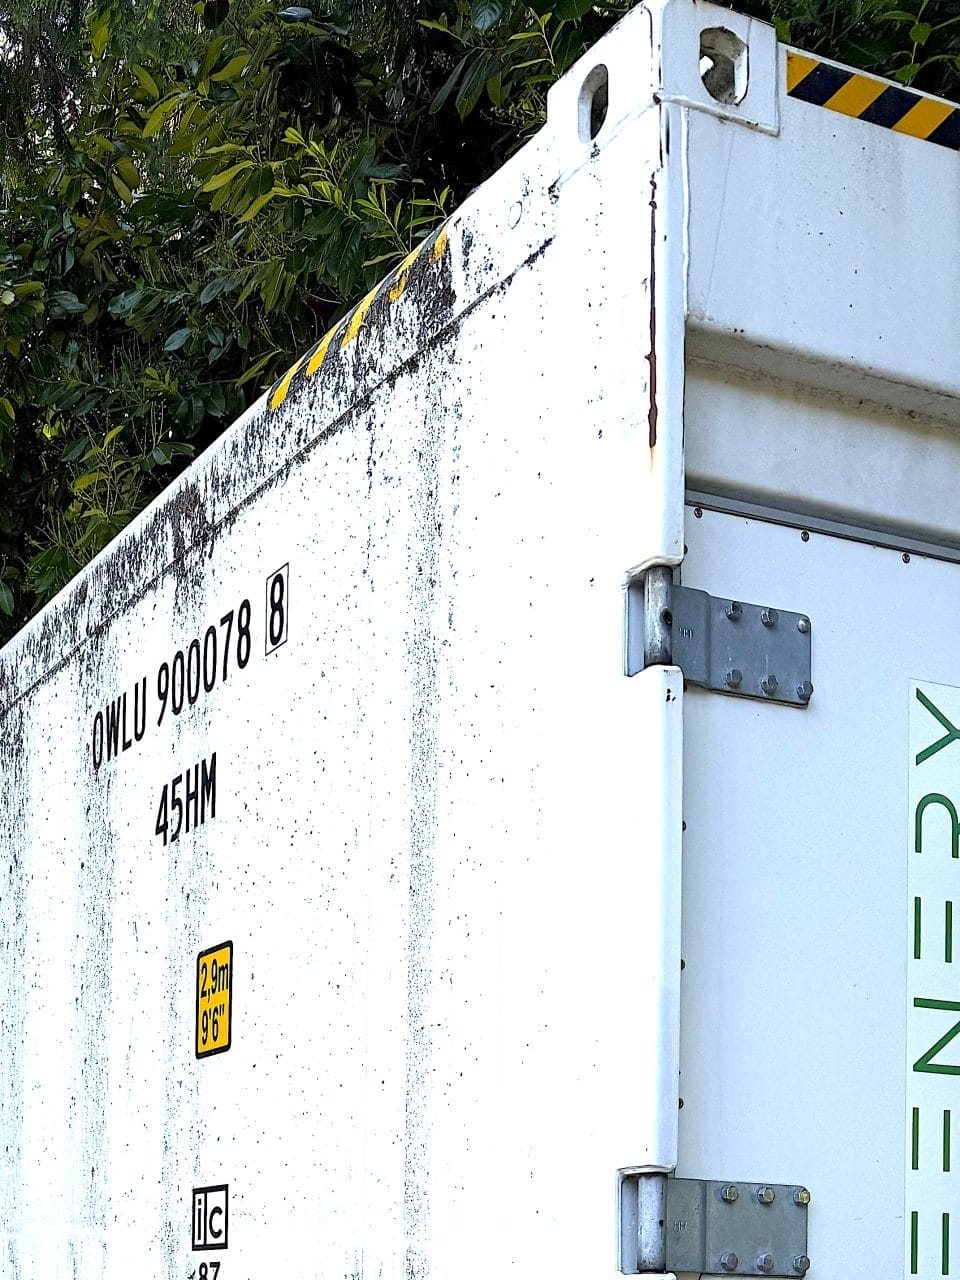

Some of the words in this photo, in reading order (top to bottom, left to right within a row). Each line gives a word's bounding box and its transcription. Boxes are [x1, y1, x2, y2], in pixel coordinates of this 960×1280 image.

[92, 676, 147, 770] OWLU
[157, 599, 251, 728] 900078
[269, 573, 284, 646] 8
[155, 752, 216, 846] 45HM
[201, 958, 229, 1003] 2,9m
[202, 1003, 224, 1046] 9'6"
